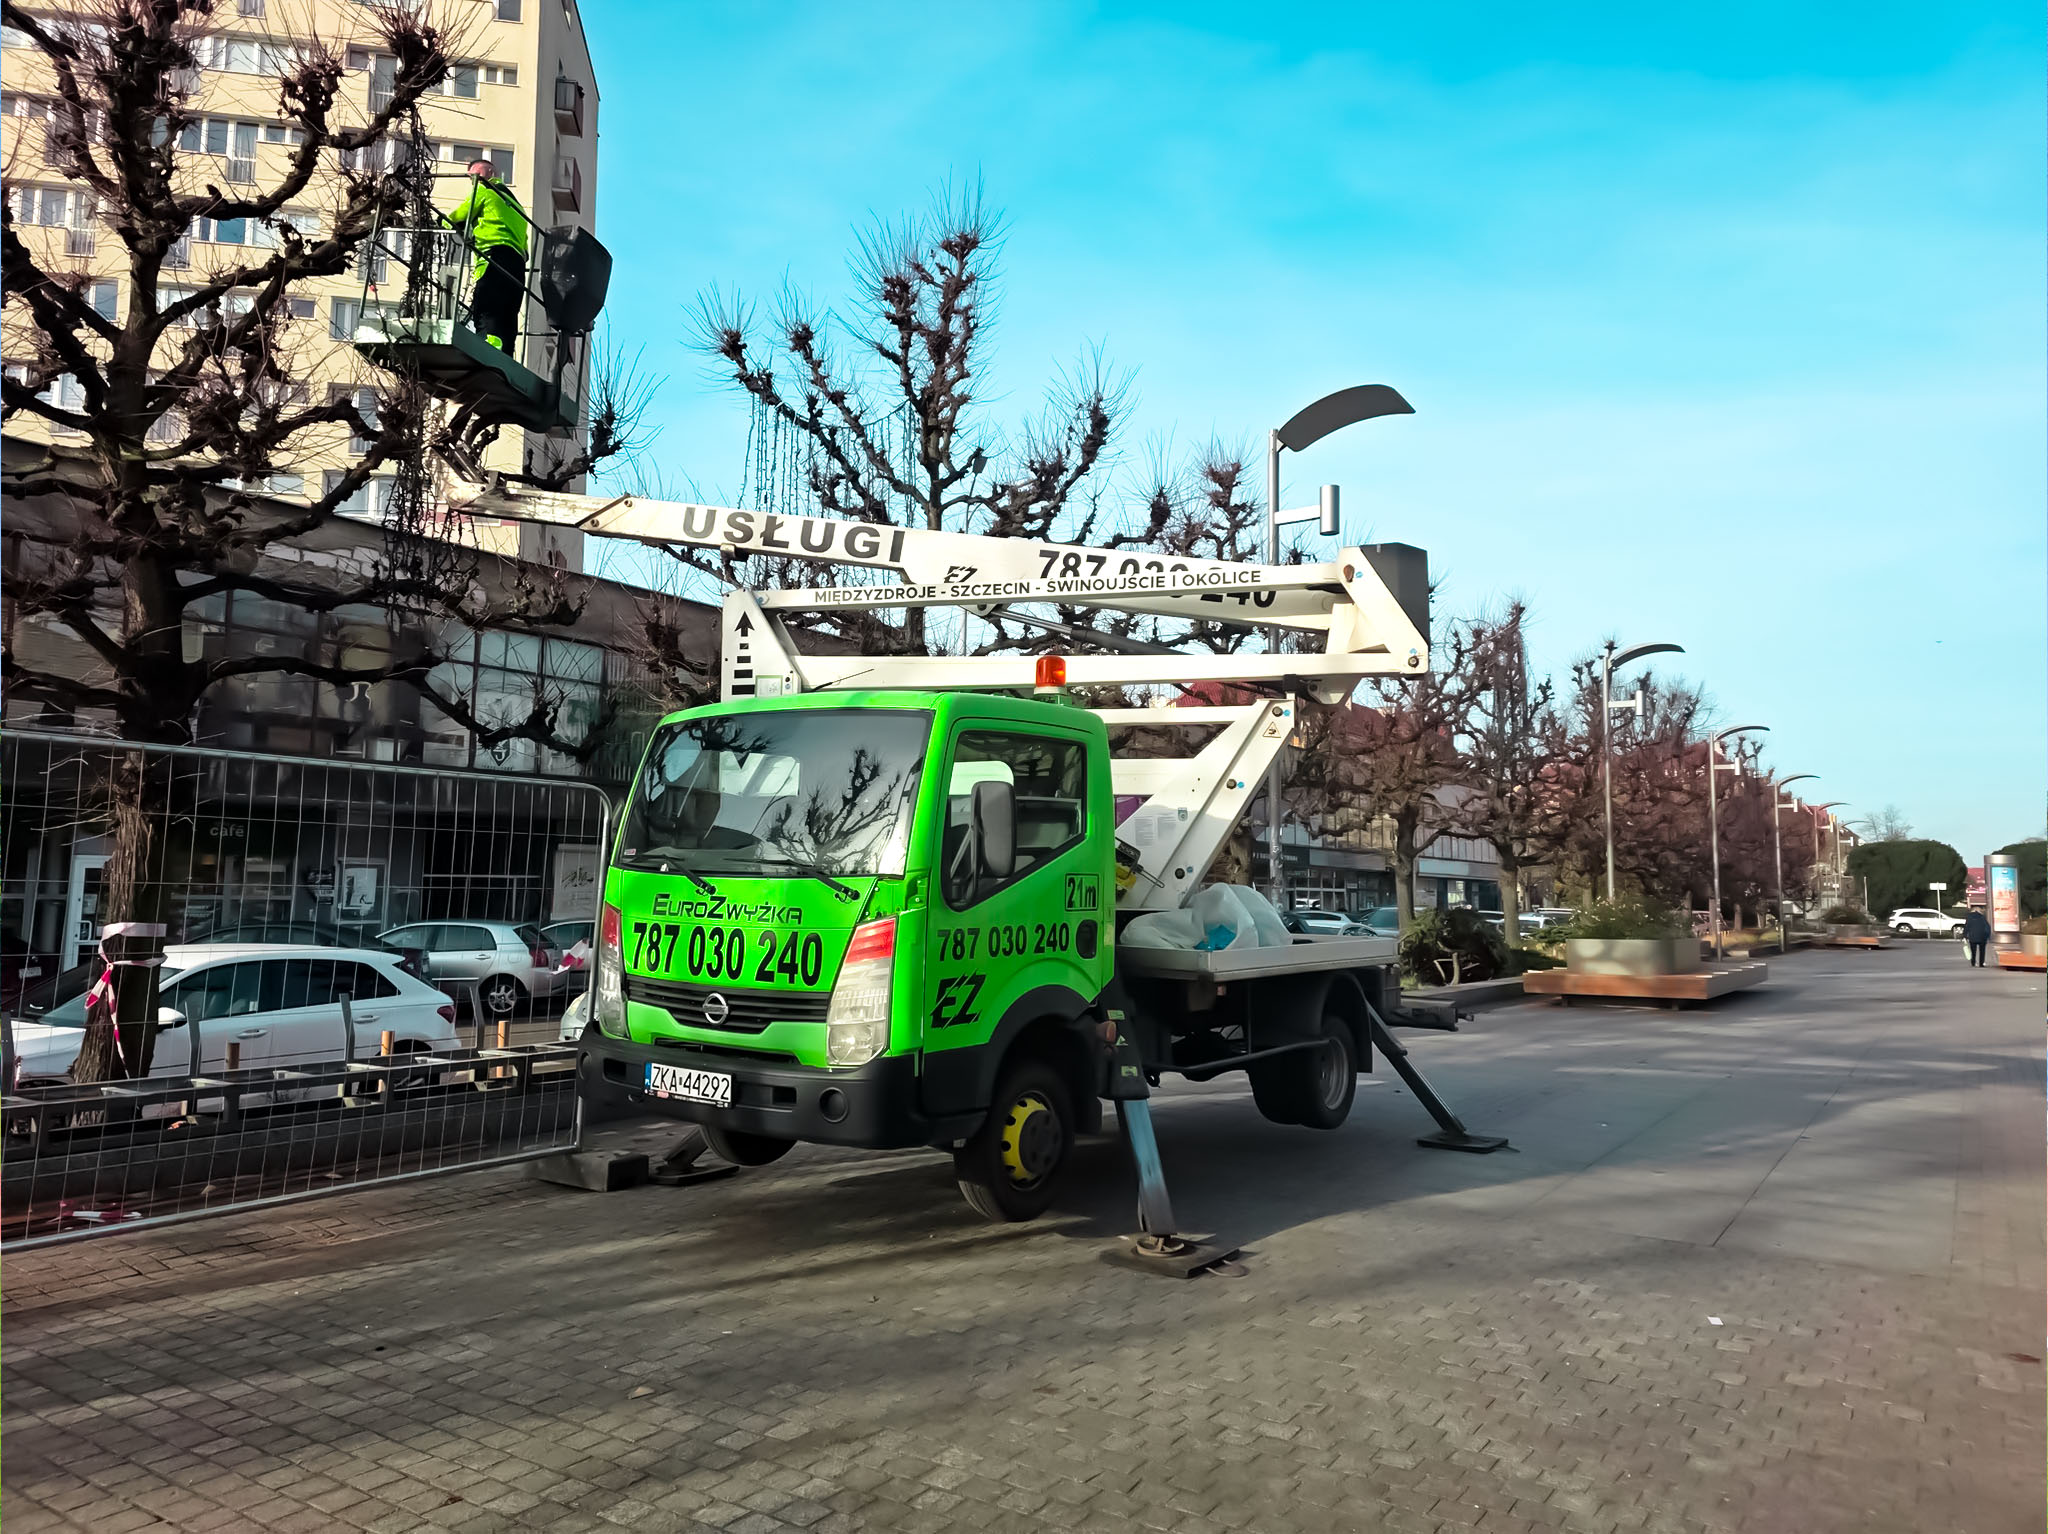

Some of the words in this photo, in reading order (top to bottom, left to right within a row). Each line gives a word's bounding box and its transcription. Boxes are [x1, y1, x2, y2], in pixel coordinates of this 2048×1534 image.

[683, 506, 906, 563] USŁUGI
[814, 586, 937, 605] MIĘDZYZDROJE
[950, 581, 1030, 598] SZCZECIN
[1046, 573, 1166, 594] ŚWINOUJŚCIE
[1172, 575, 1176, 588] I
[1182, 570, 1262, 587] OKOLICE
[1067, 876, 1097, 909] 21m
[632, 921, 682, 975] 787
[688, 925, 746, 980] 030
[755, 930, 823, 987] 240
[937, 927, 981, 962] 787
[988, 924, 1028, 958] 030
[1033, 922, 1070, 955] 240
[930, 969, 987, 1030] EZ
[683, 1071, 730, 1100] 44292
